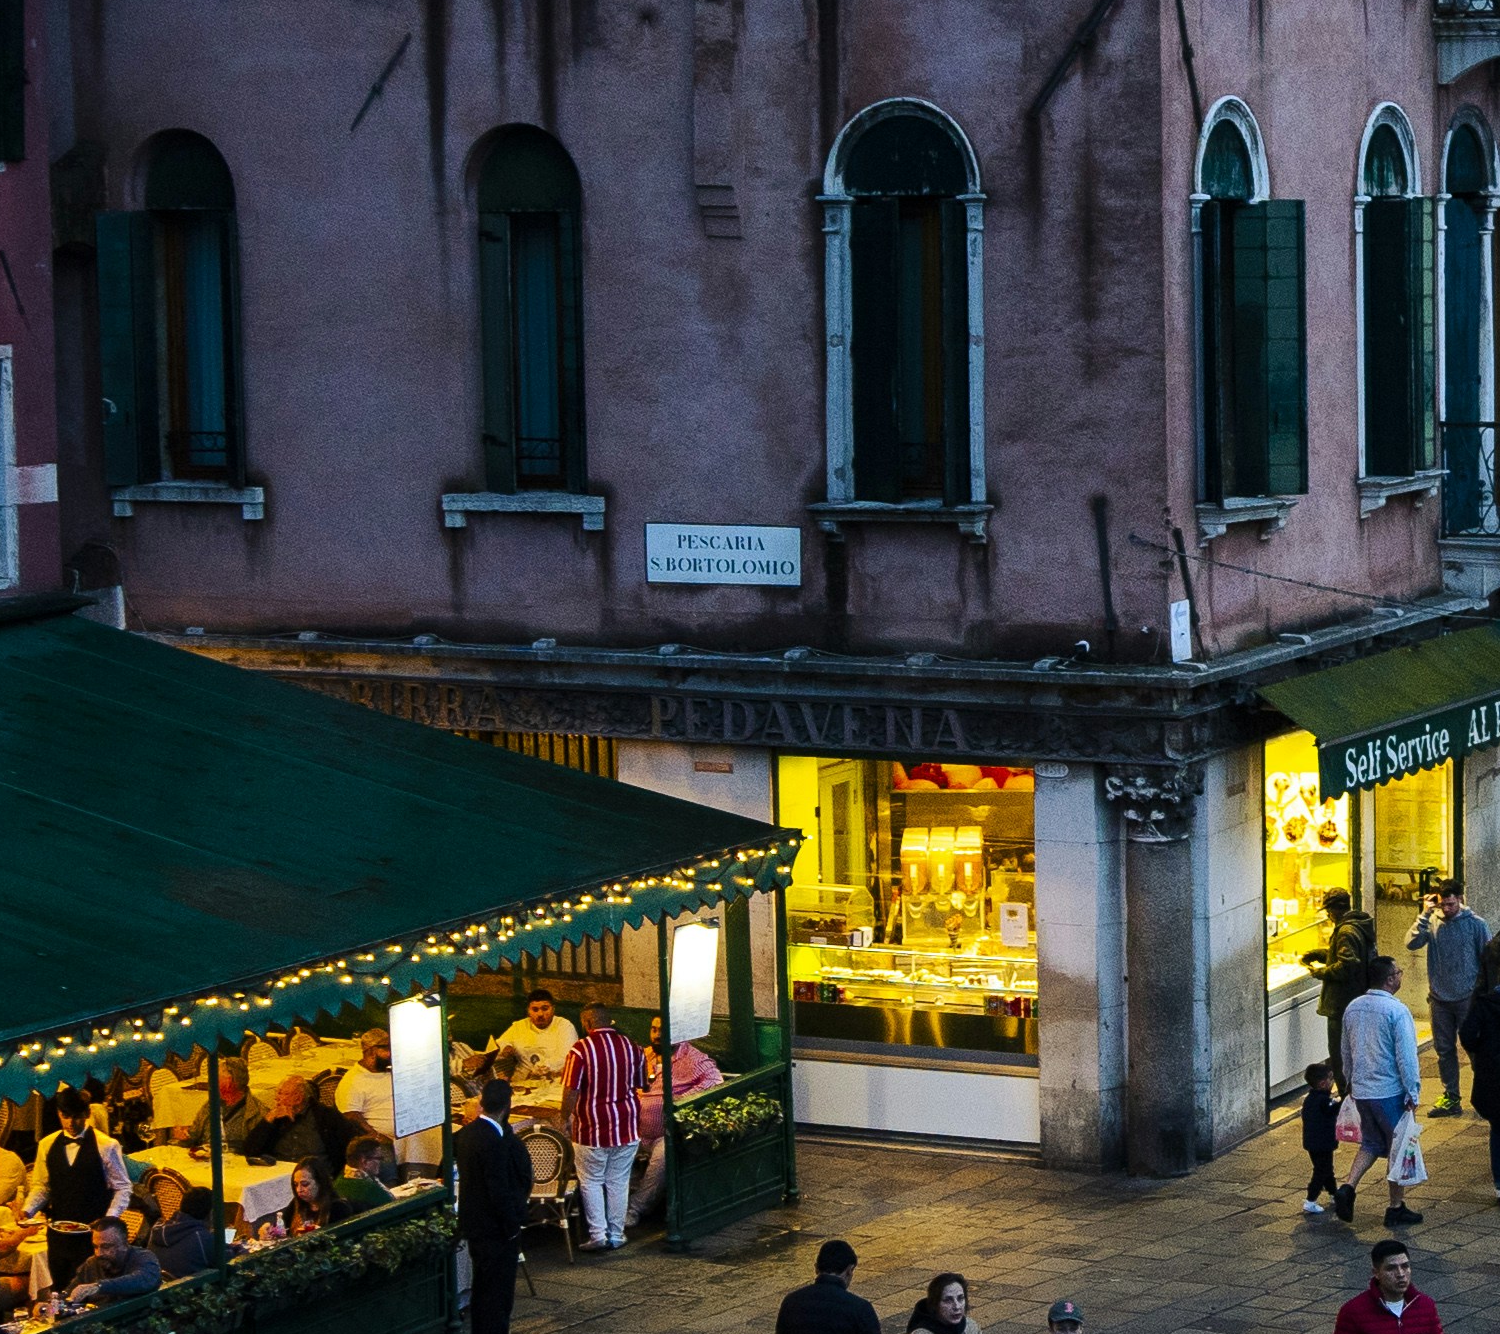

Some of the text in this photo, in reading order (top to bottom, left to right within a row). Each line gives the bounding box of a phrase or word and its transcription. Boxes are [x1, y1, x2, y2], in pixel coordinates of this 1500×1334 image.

[677, 534, 765, 551] PESCARIA
[651, 695, 972, 751] PEDAVENA
[1345, 738, 1382, 788] Self
[1385, 723, 1450, 774] Service
[1467, 706, 1491, 747] AL
